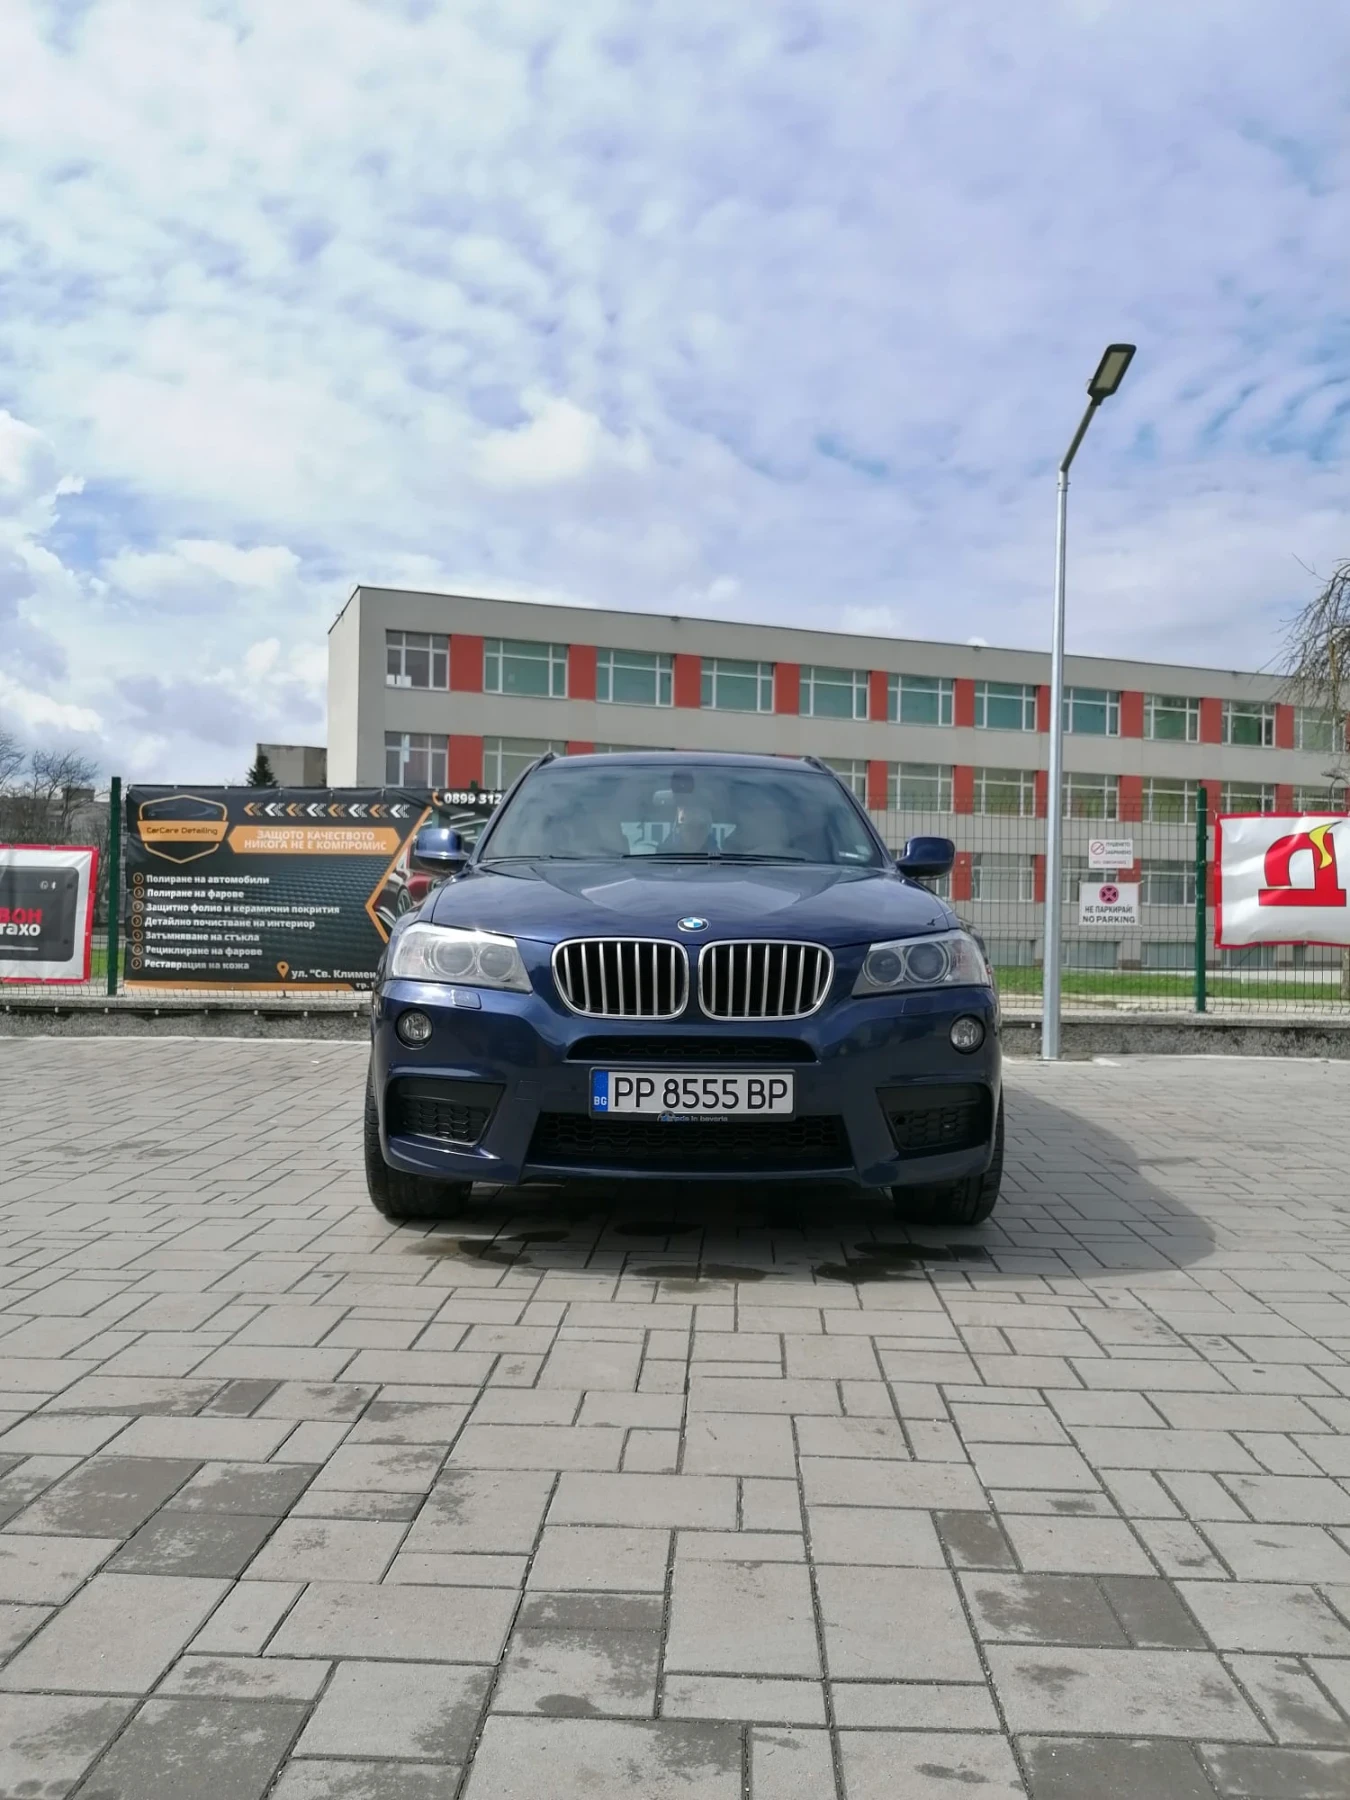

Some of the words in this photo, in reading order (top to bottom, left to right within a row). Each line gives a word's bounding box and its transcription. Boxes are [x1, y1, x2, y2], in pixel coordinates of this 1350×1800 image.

[444, 792, 476, 804] 0899
[478, 793, 502, 805] 312
[146, 826, 179, 835] CarCare
[181, 826, 218, 836] Detailing
[256, 830, 304, 841] ЗАЩОТО
[307, 831, 374, 841] КАЧЕСТВОТО
[244, 839, 287, 849] НИКОГА
[290, 840, 304, 849] НЕ
[307, 841, 313, 849] Е
[316, 841, 387, 850] КОМПРОМИС
[146, 875, 192, 886] Полиране
[207, 875, 269, 884] автомобили
[147, 889, 193, 900] Полиране
[194, 890, 206, 898] на
[207, 889, 244, 900] фарове
[145, 902, 189, 913] Защитно
[191, 903, 222, 914] фолио
[233, 905, 290, 915] керамични
[292, 906, 340, 915] покрития
[144, 917, 192, 927] Детайлно
[193, 919, 251, 927] почистване
[267, 919, 315, 929] интериор
[145, 932, 209, 941] Затъмняване
[224, 934, 260, 942] стъкла
[145, 946, 209, 957] Рециклиране
[211, 947, 223, 955] на
[225, 946, 263, 957] фарове
[144, 959, 206, 970] Реставрация
[208, 961, 220, 969] на
[291, 970, 308, 979] ул.
[614, 1077, 655, 1108] PP
[662, 1078, 740, 1109] 8555
[747, 1079, 788, 1109] BP
[593, 1096, 608, 1106] BG
